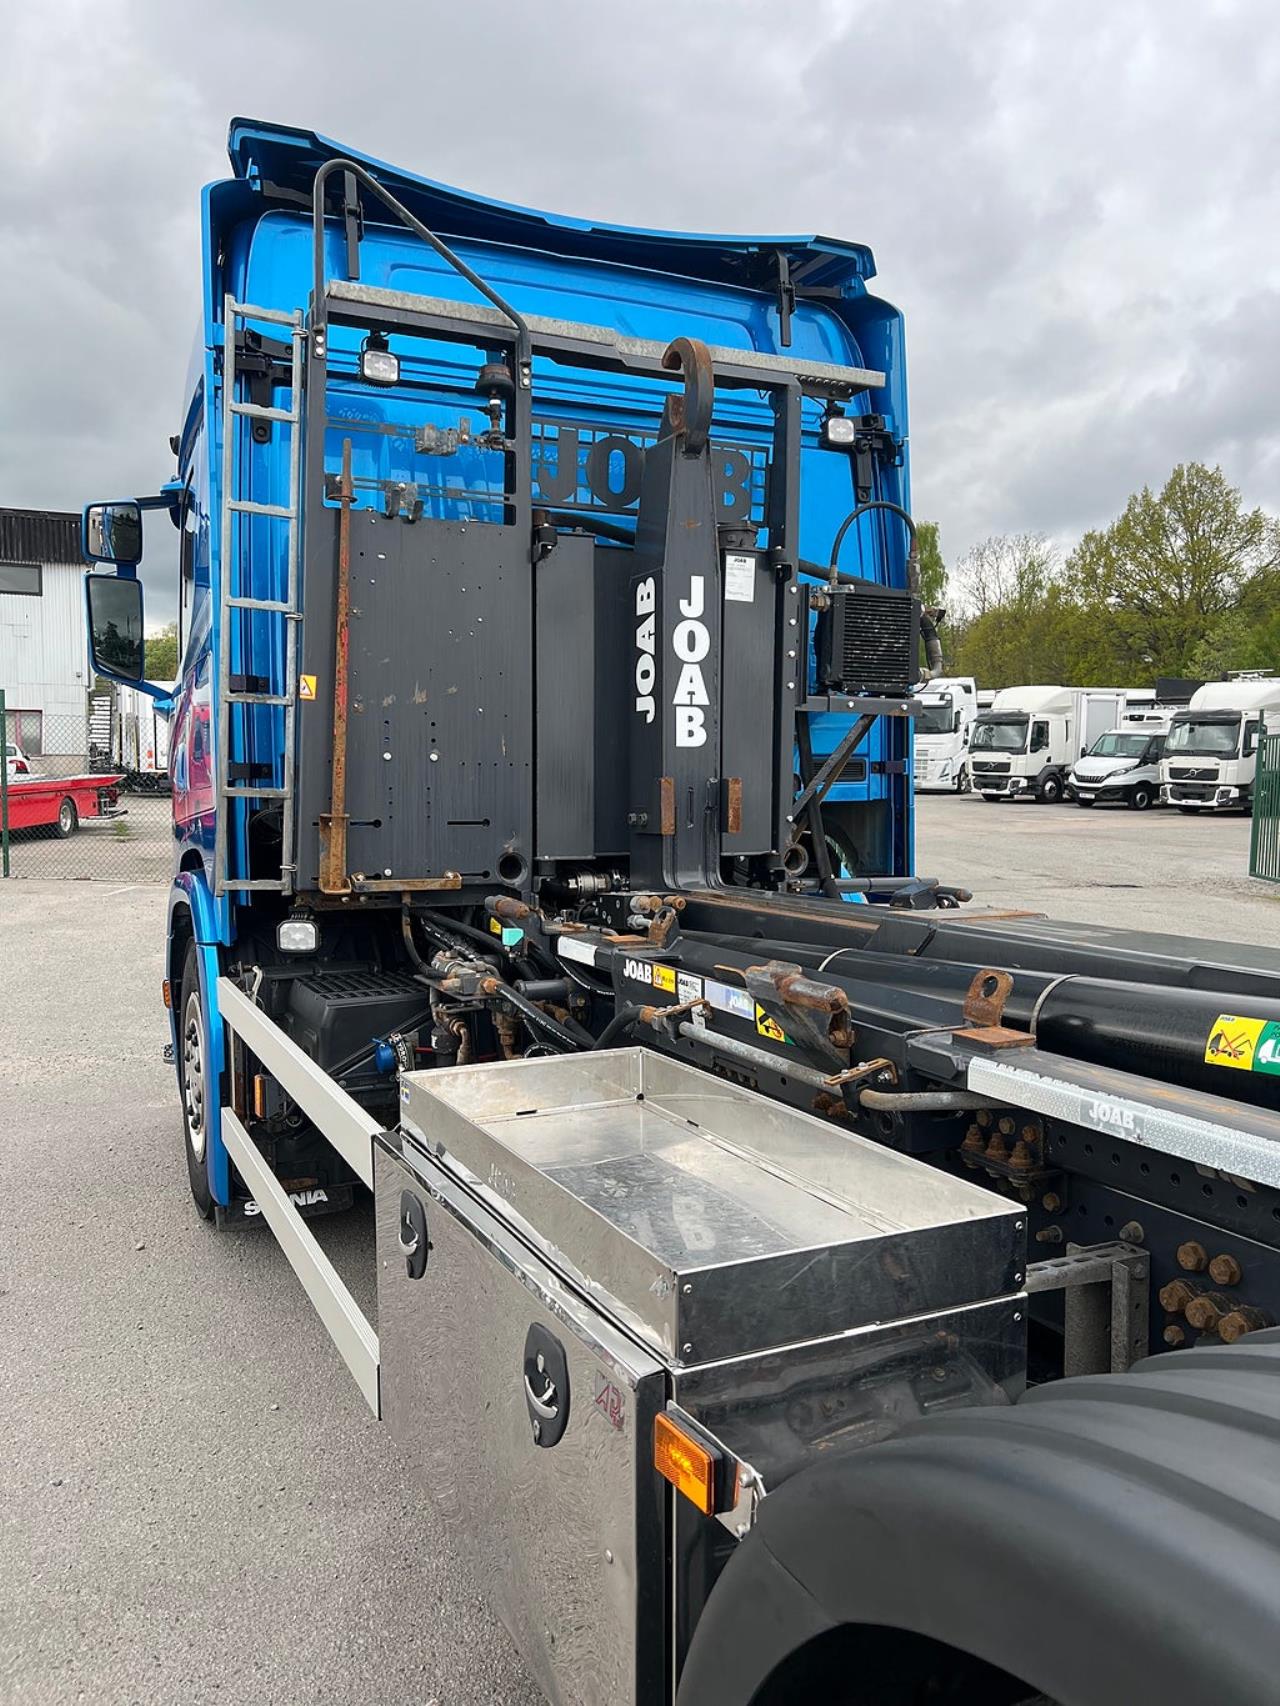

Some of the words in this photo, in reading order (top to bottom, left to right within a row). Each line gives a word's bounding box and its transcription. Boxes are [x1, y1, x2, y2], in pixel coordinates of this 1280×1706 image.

[538, 426, 751, 522] JOB
[636, 576, 656, 724] JOAB
[672, 575, 711, 748] JOAB
[623, 959, 652, 984] JOAB
[1088, 1100, 1135, 1130] JOAB
[243, 1189, 329, 1216] SNIA
